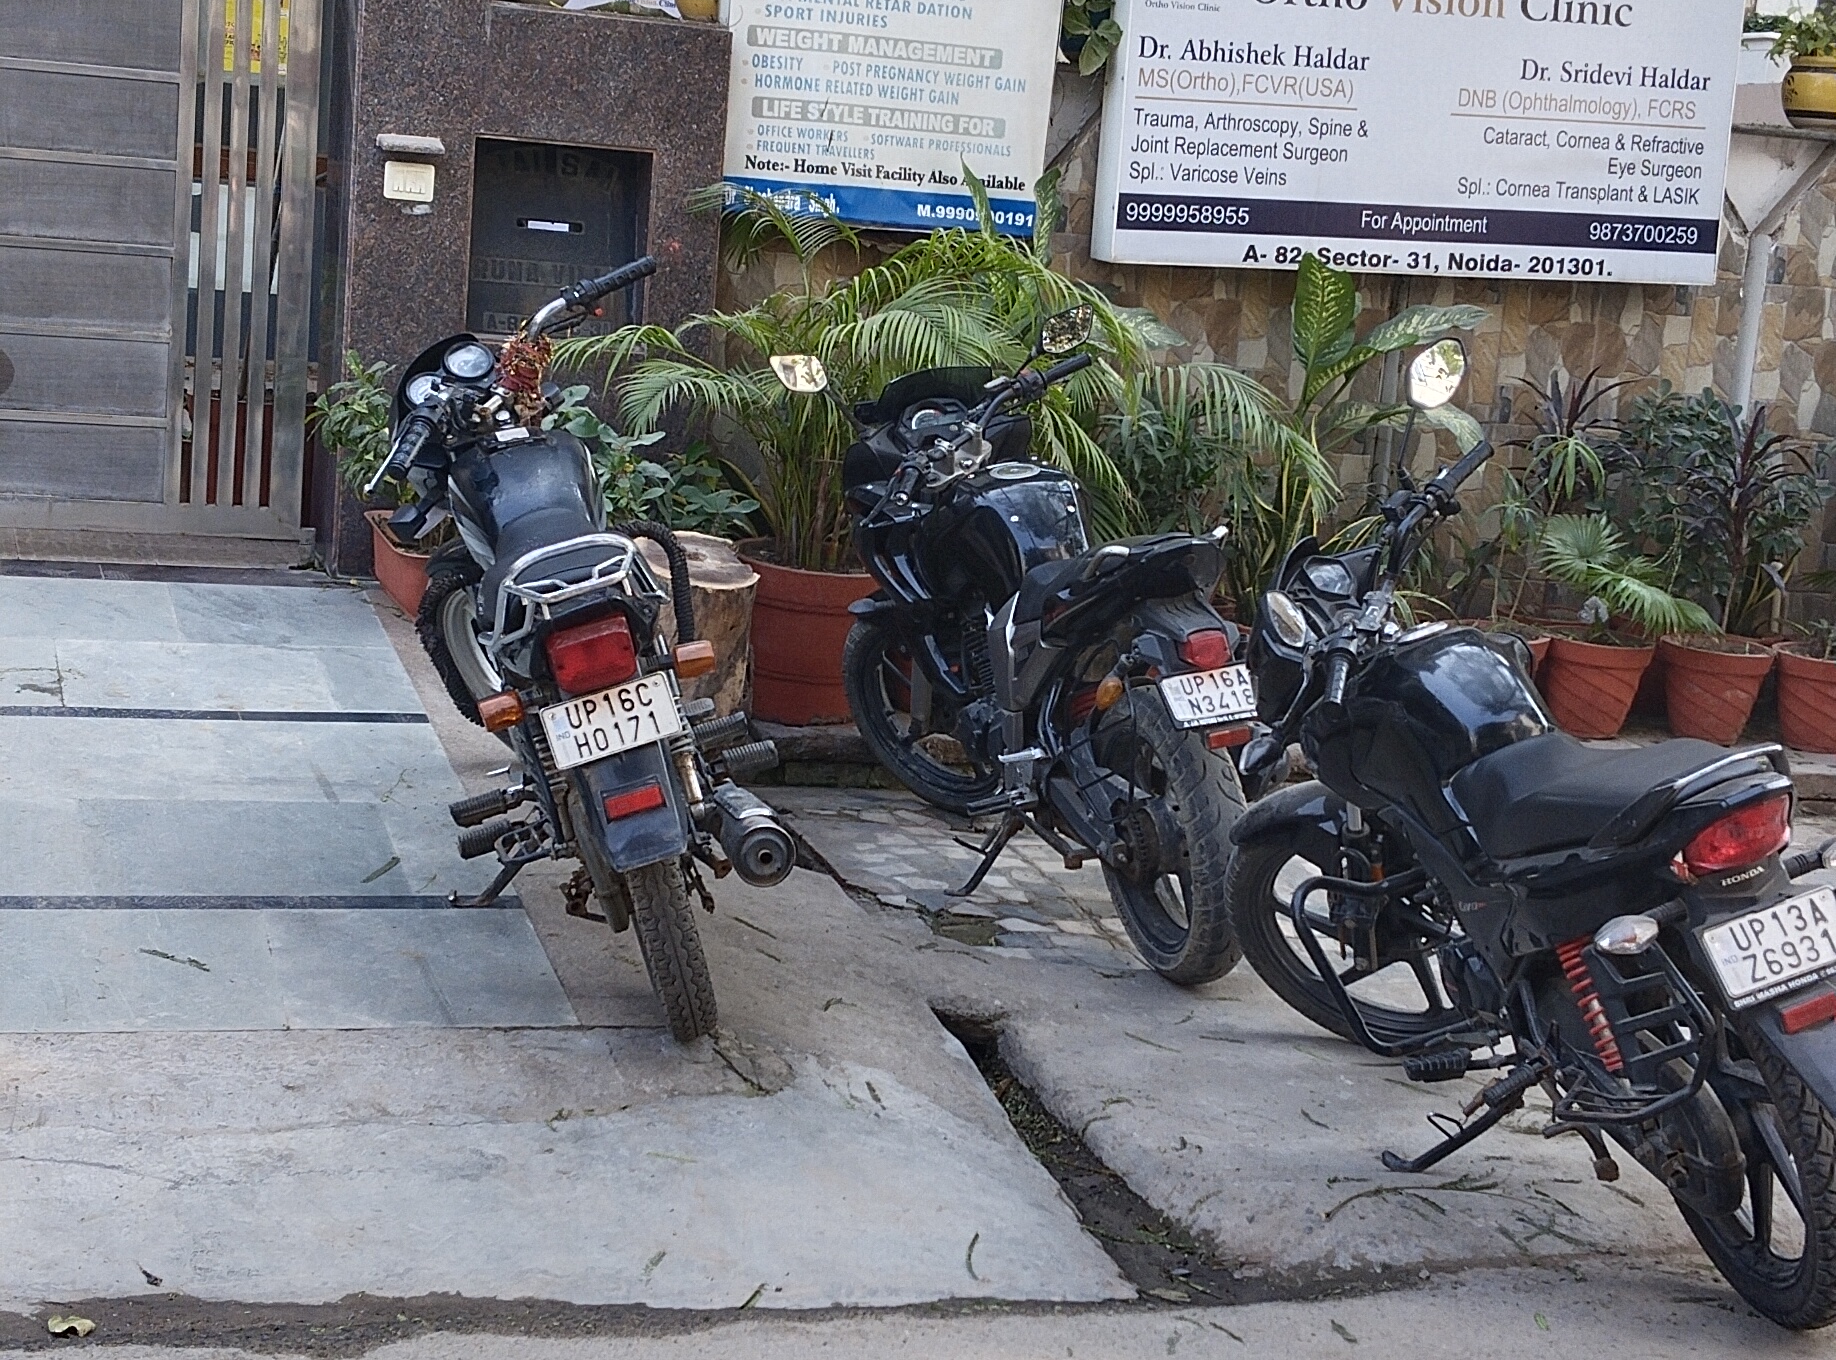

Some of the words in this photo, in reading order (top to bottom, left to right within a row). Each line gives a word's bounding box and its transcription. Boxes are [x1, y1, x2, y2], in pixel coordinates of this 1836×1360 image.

[764, 4, 814, 21] SPORT
[820, 9, 888, 28] INJURIES
[917, 1, 973, 20] DATION
[1145, 0, 1169, 9] Ortho
[1171, 0, 1195, 11] Vision
[1197, 2, 1221, 13] Clinic
[755, 27, 843, 51] WEIGHT
[848, 35, 995, 67] MANAGEMENT
[1138, 35, 1171, 60] Dr.
[1179, 39, 1287, 67] Abhishek
[1293, 45, 1371, 71] Haldar
[752, 53, 804, 71] OBESITY
[832, 60, 862, 77] POST
[865, 64, 940, 85] PREGNANCY
[944, 71, 990, 89] WEIGHT
[994, 77, 1027, 93] GAIN
[1520, 58, 1551, 82] Dr.
[1560, 60, 1633, 87] Sridevi
[1639, 66, 1712, 92] Haldar
[754, 73, 820, 93] HORMONE
[825, 79, 873, 97] RELATED
[877, 84, 925, 102] WEIGHT
[928, 90, 960, 105] GAIN
[1458, 88, 1497, 109] DNB
[1647, 99, 1697, 120] FCRS
[762, 99, 802, 119] LIFE
[807, 103, 864, 124] STYLE
[868, 108, 954, 133] TRAINING
[958, 116, 995, 136] FOR
[1134, 108, 1199, 132] Trauma,
[1204, 112, 1302, 138] Arthroscopy,
[1308, 117, 1352, 140] Spine
[1357, 120, 1369, 138] &
[756, 139, 811, 155] FREQUENT
[816, 145, 876, 161] TRAVELLERS
[757, 124, 793, 139] OFFICE
[796, 127, 849, 142] WORKERS
[871, 133, 925, 149] SOFTWARE
[928, 139, 1012, 157] PROFESSIONALS
[1131, 135, 1169, 154] Joint
[1174, 137, 1278, 160] Replacement
[1282, 142, 1349, 165] Surgeon
[1483, 126, 1551, 149] Cataract,
[1556, 130, 1610, 151] Cornea
[1615, 133, 1625, 152] &
[1631, 134, 1705, 155] Refractive
[745, 154, 790, 172] Note:-
[793, 158, 838, 175] Home
[841, 162, 873, 179] Visit
[875, 164, 926, 186] Facility
[928, 170, 958, 186] Also
[960, 174, 1026, 191] ailable
[1129, 161, 1164, 184] Spl.:
[1170, 163, 1238, 184] Varicose
[1244, 167, 1287, 186] Veins
[1607, 157, 1636, 179] Eye
[1640, 159, 1702, 182] Surgeon
[1457, 176, 1491, 199] Spl.:
[1496, 178, 1551, 199] Cornea
[1556, 180, 1634, 205] Transplant
[1638, 185, 1649, 203] &
[1653, 186, 1700, 205] LASIK
[917, 204, 1034, 228] M.99900191
[1125, 201, 1251, 227] 9999958955
[1361, 210, 1387, 230] For
[1390, 212, 1488, 235] Appointment
[1589, 221, 1698, 245] 9873700259
[1317, 246, 1399, 270] Sector-
[1406, 251, 1439, 273] 31,
[1448, 252, 1521, 273] Noida-
[1527, 255, 1613, 277] 201301.
[574, 710, 661, 759] H0171
[1719, 865, 1766, 887] HONDA
[1742, 927, 1836, 984] Z6931
[1788, 972, 1820, 989] HONDA
